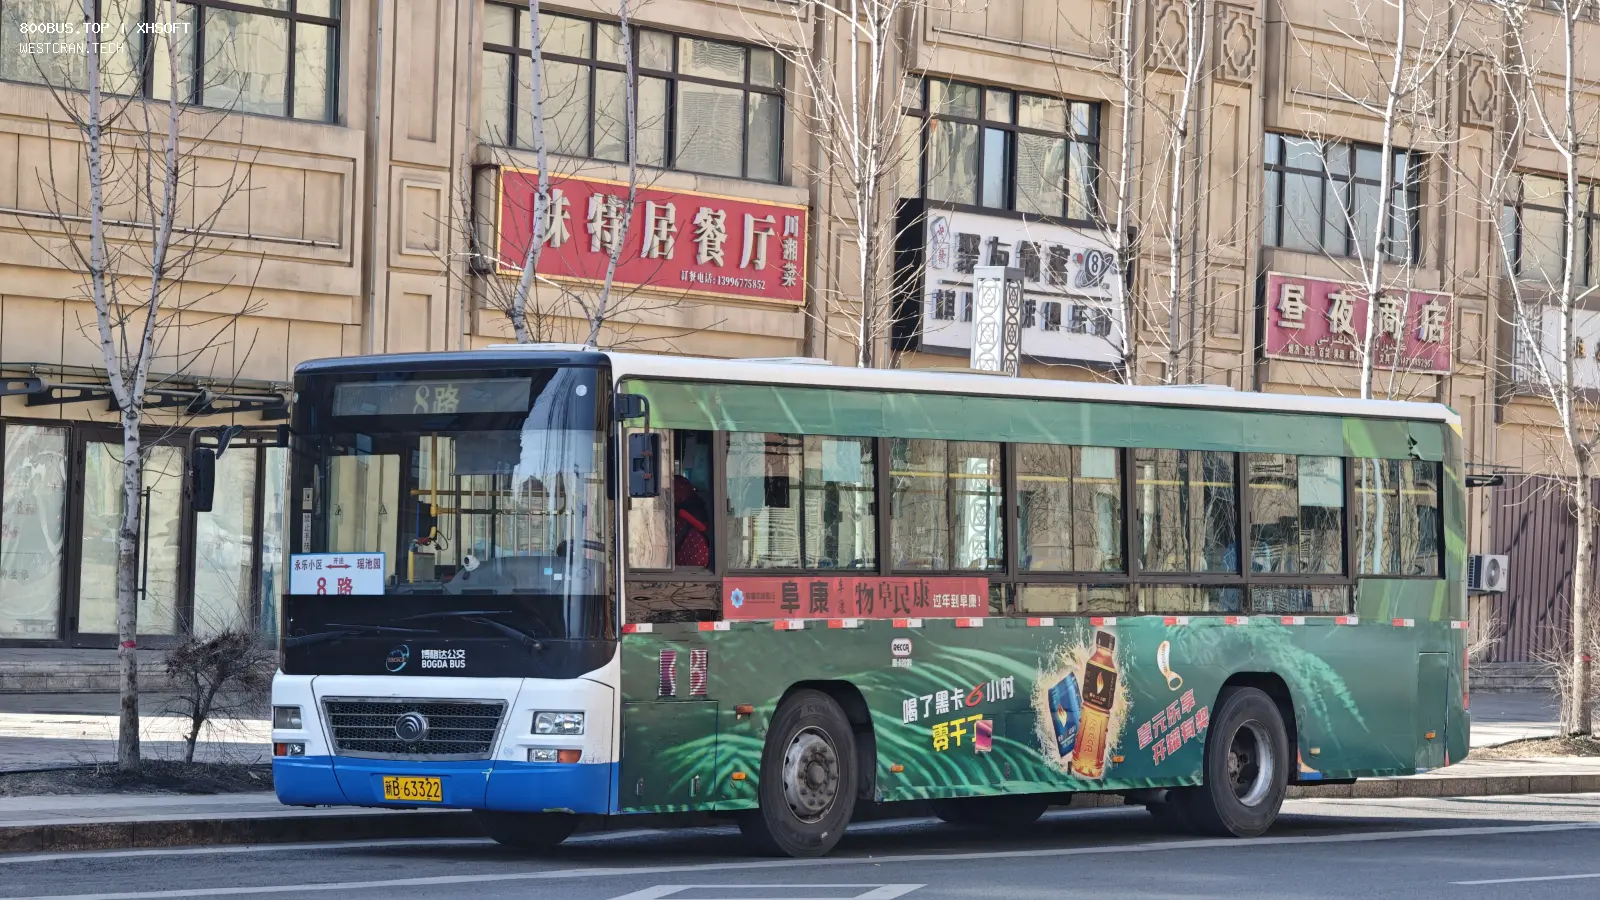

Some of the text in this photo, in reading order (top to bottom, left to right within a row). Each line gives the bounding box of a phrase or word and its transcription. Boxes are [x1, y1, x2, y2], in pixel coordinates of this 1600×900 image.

[782, 215, 799, 287] 川湘菜
[1276, 284, 1447, 343] 昼夜商店
[413, 382, 460, 414] 8路
[294, 557, 381, 571] 永乐小区 瑶池园
[421, 659, 466, 668] BOGDA BUS
